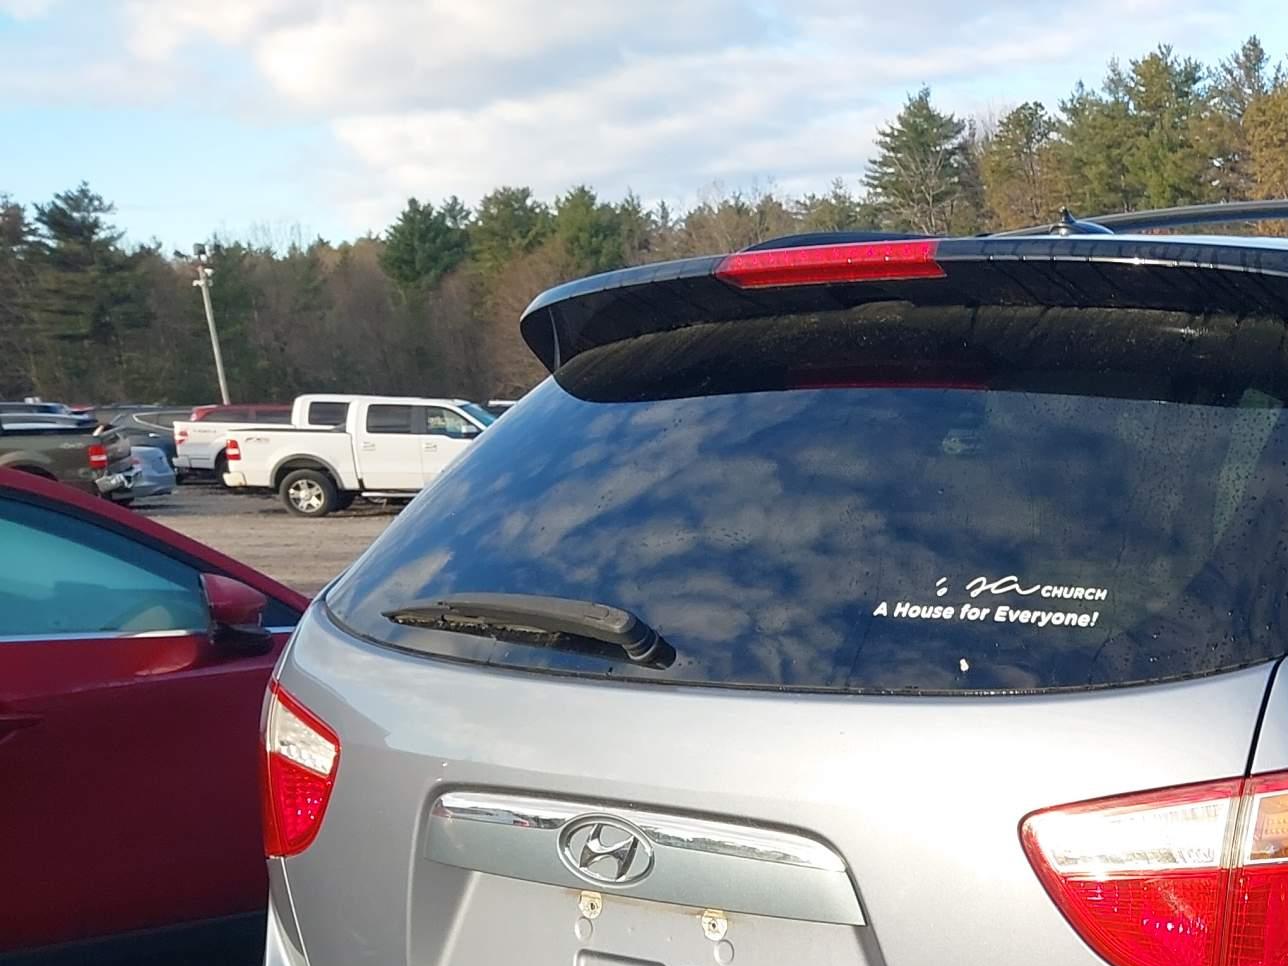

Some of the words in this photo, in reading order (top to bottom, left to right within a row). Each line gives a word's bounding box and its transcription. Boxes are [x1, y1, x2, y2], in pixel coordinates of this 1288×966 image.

[1041, 585, 1108, 601] CHURCH
[873, 602, 888, 617] A
[893, 602, 955, 620] House
[959, 603, 991, 621] for
[993, 605, 1100, 627] Everyone!
